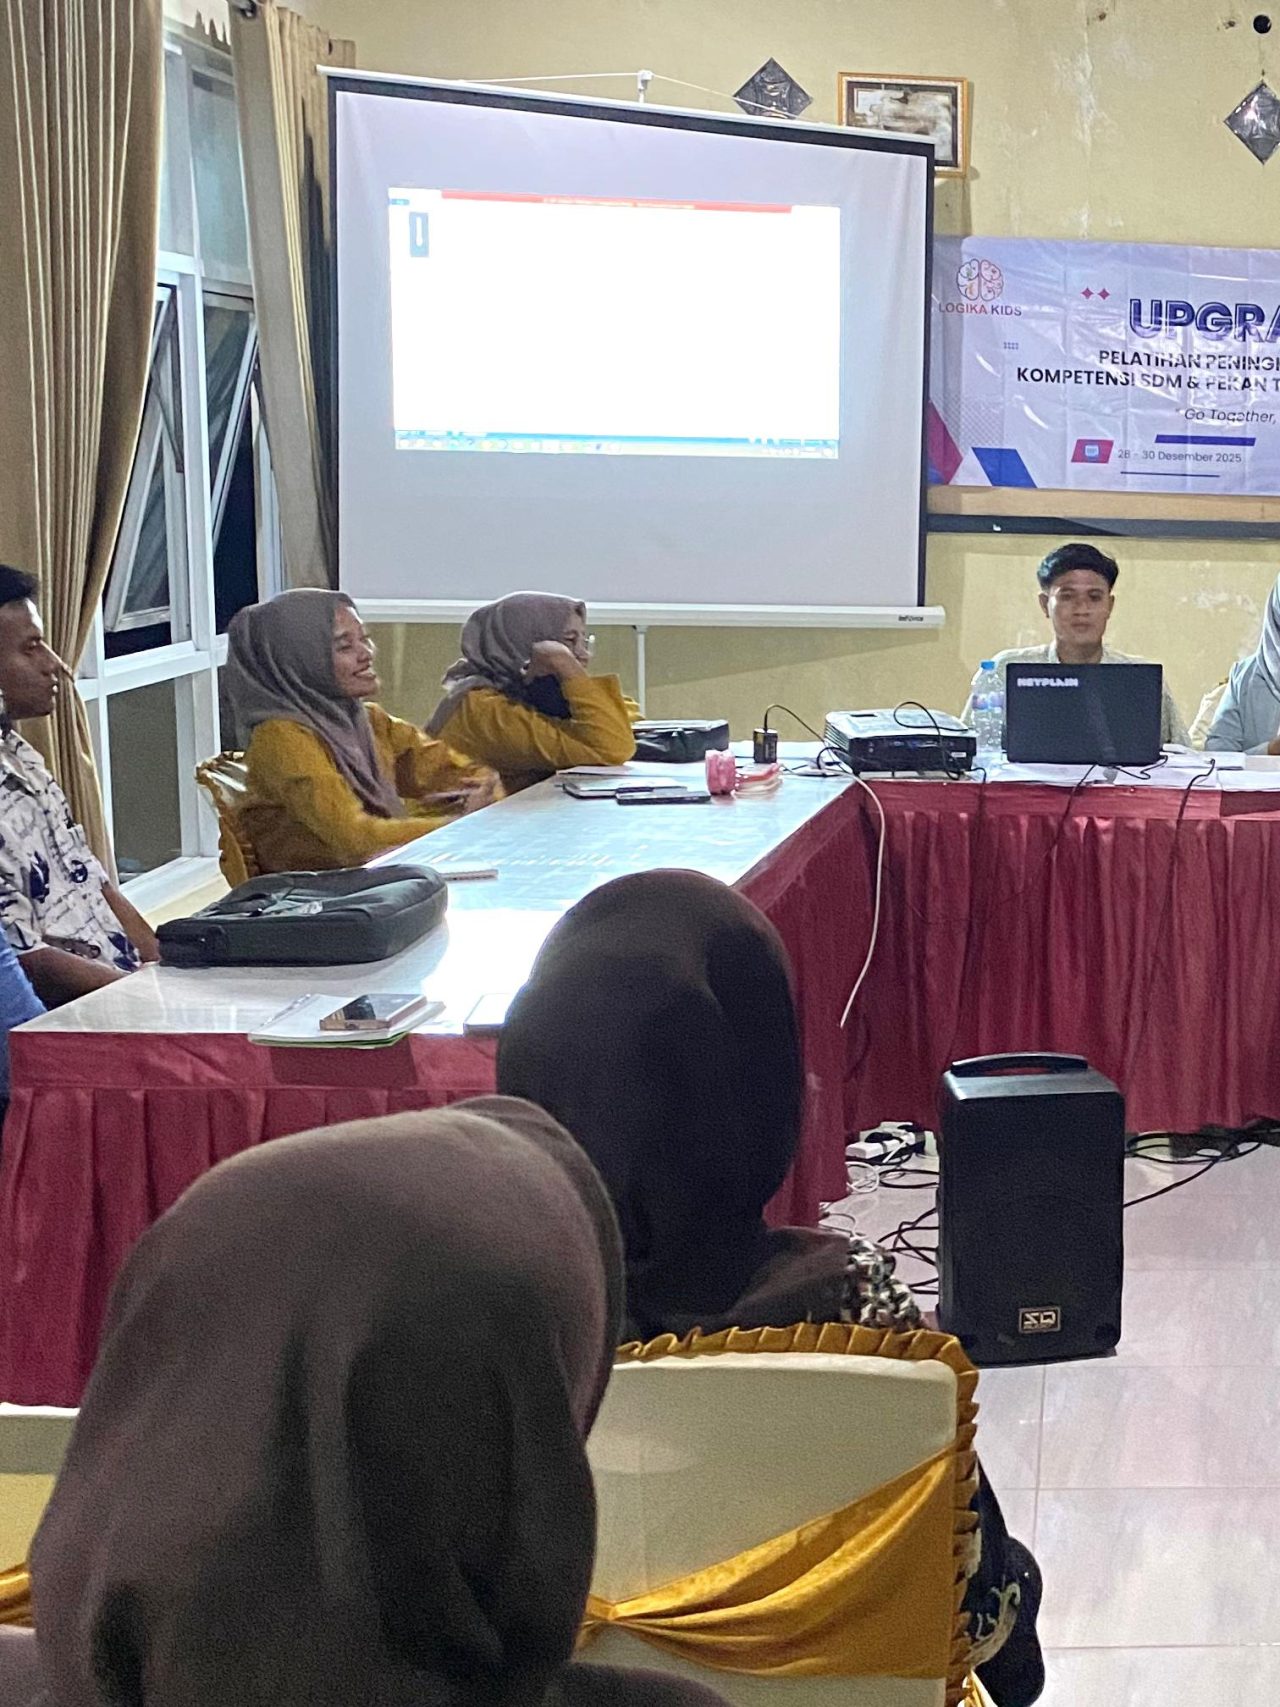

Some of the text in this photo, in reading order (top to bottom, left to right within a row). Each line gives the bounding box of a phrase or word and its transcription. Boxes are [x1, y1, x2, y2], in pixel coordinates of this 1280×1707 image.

[938, 302, 1022, 317] LOGIKA KIDS
[1099, 350, 1201, 369] PELATIHAN
[1017, 367, 1135, 387] KOMPETENSI
[1140, 373, 1182, 389] SDM
[1186, 375, 1201, 390] &
[1206, 375, 1267, 392] PEKAN
[1184, 408, 1205, 420] Go
[1142, 450, 1156, 460] 30
[1158, 451, 1214, 462] Desember
[1215, 452, 1242, 463] 2025
